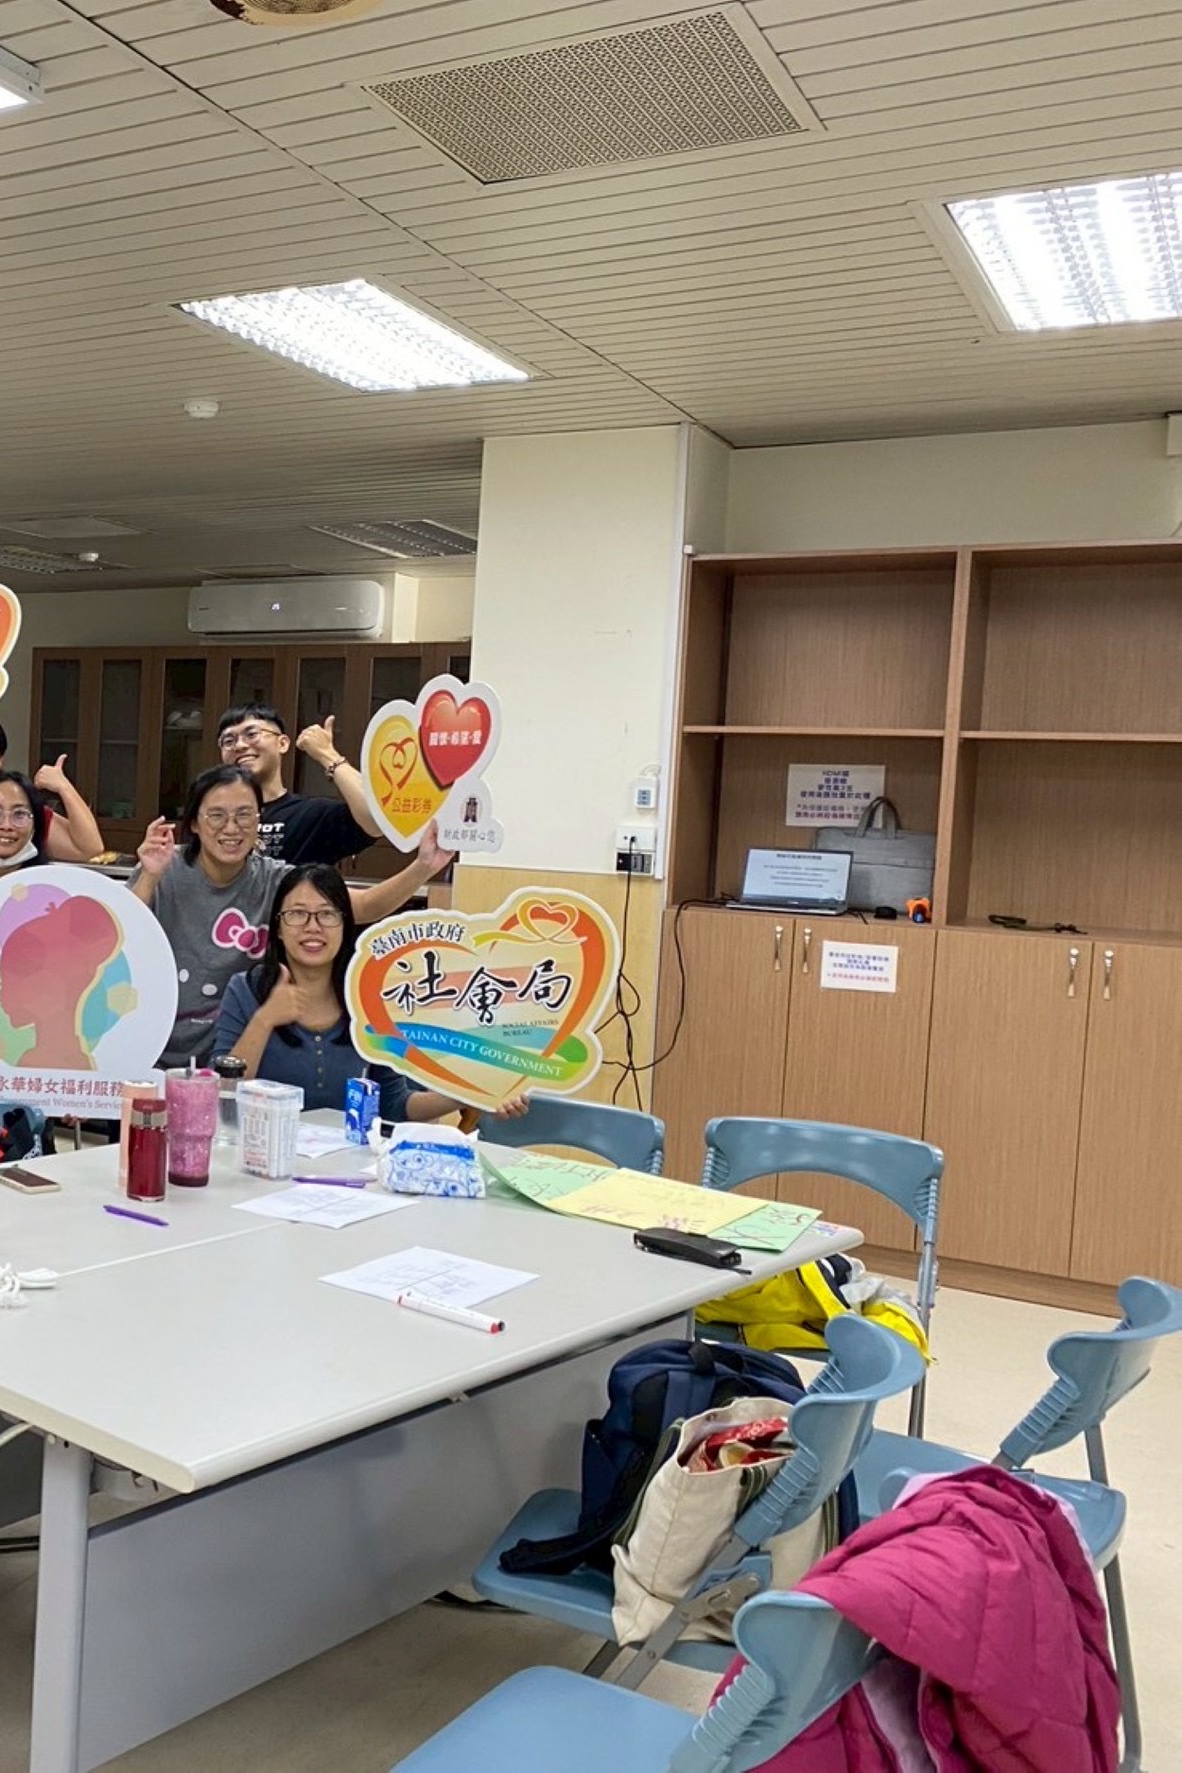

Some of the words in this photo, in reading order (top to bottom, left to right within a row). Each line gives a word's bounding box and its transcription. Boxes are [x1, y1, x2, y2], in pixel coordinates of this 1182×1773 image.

[371, 921, 466, 956] 臺南市政府
[382, 951, 572, 1024] 社會局
[402, 1029, 449, 1044] TAINAN
[449, 1036, 478, 1052] CITY
[479, 1044, 563, 1077] GOVERNMENT
